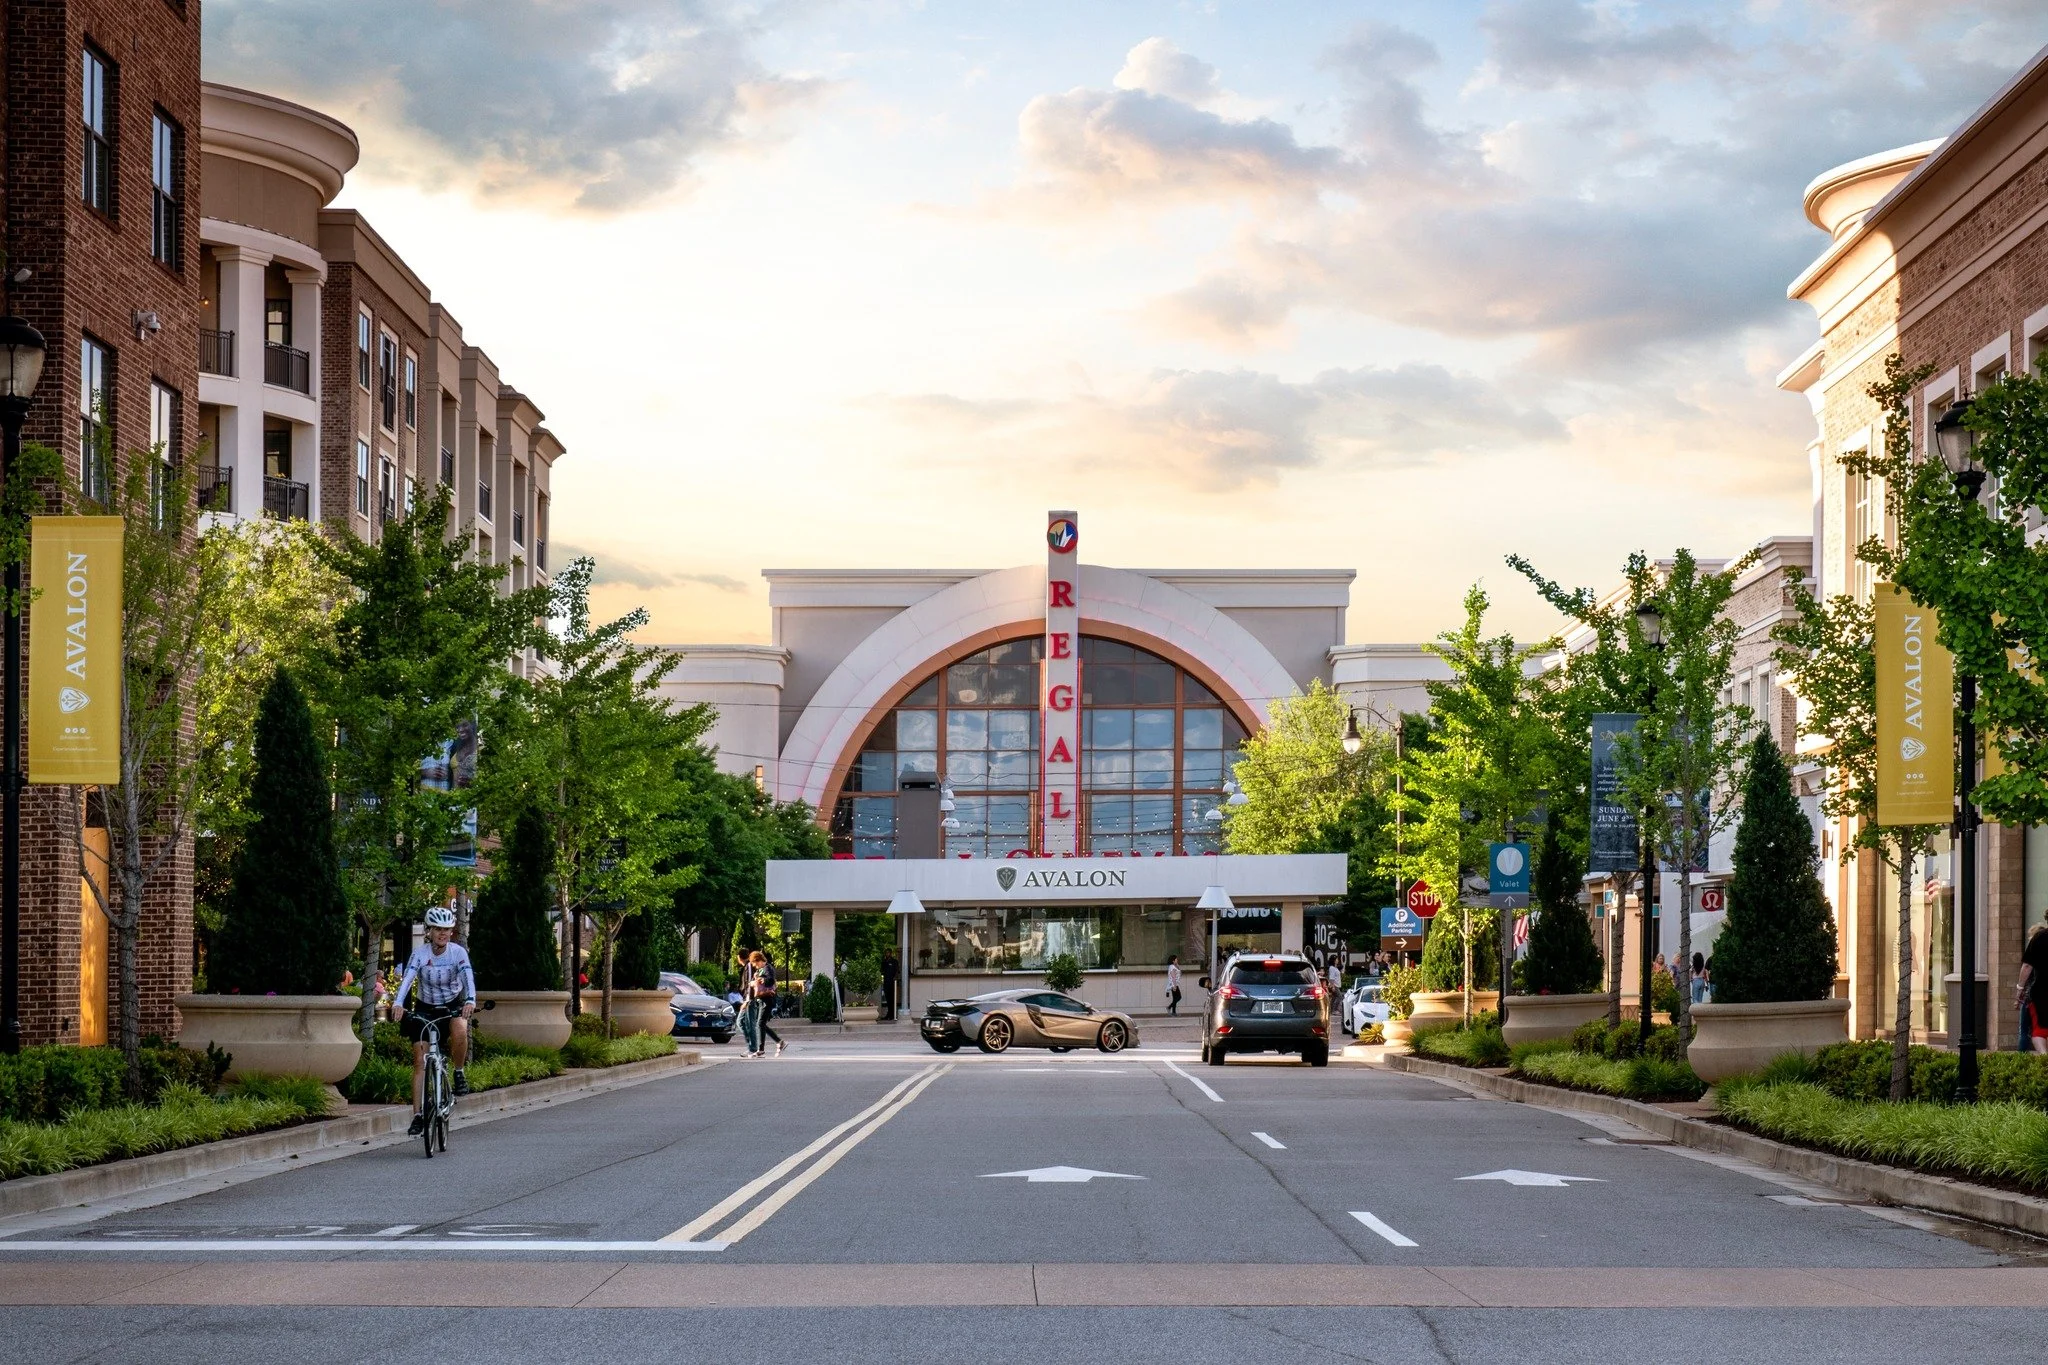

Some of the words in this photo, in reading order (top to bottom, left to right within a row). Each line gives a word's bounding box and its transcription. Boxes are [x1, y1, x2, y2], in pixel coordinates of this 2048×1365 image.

[66, 551, 88, 680] AVALON
[1047, 579, 1075, 819] REGAL
[1904, 614, 1923, 731] AVALON
[1022, 870, 1127, 888] AVALON
[1410, 891, 1441, 906] STOP
[1500, 880, 1520, 888] Valet
